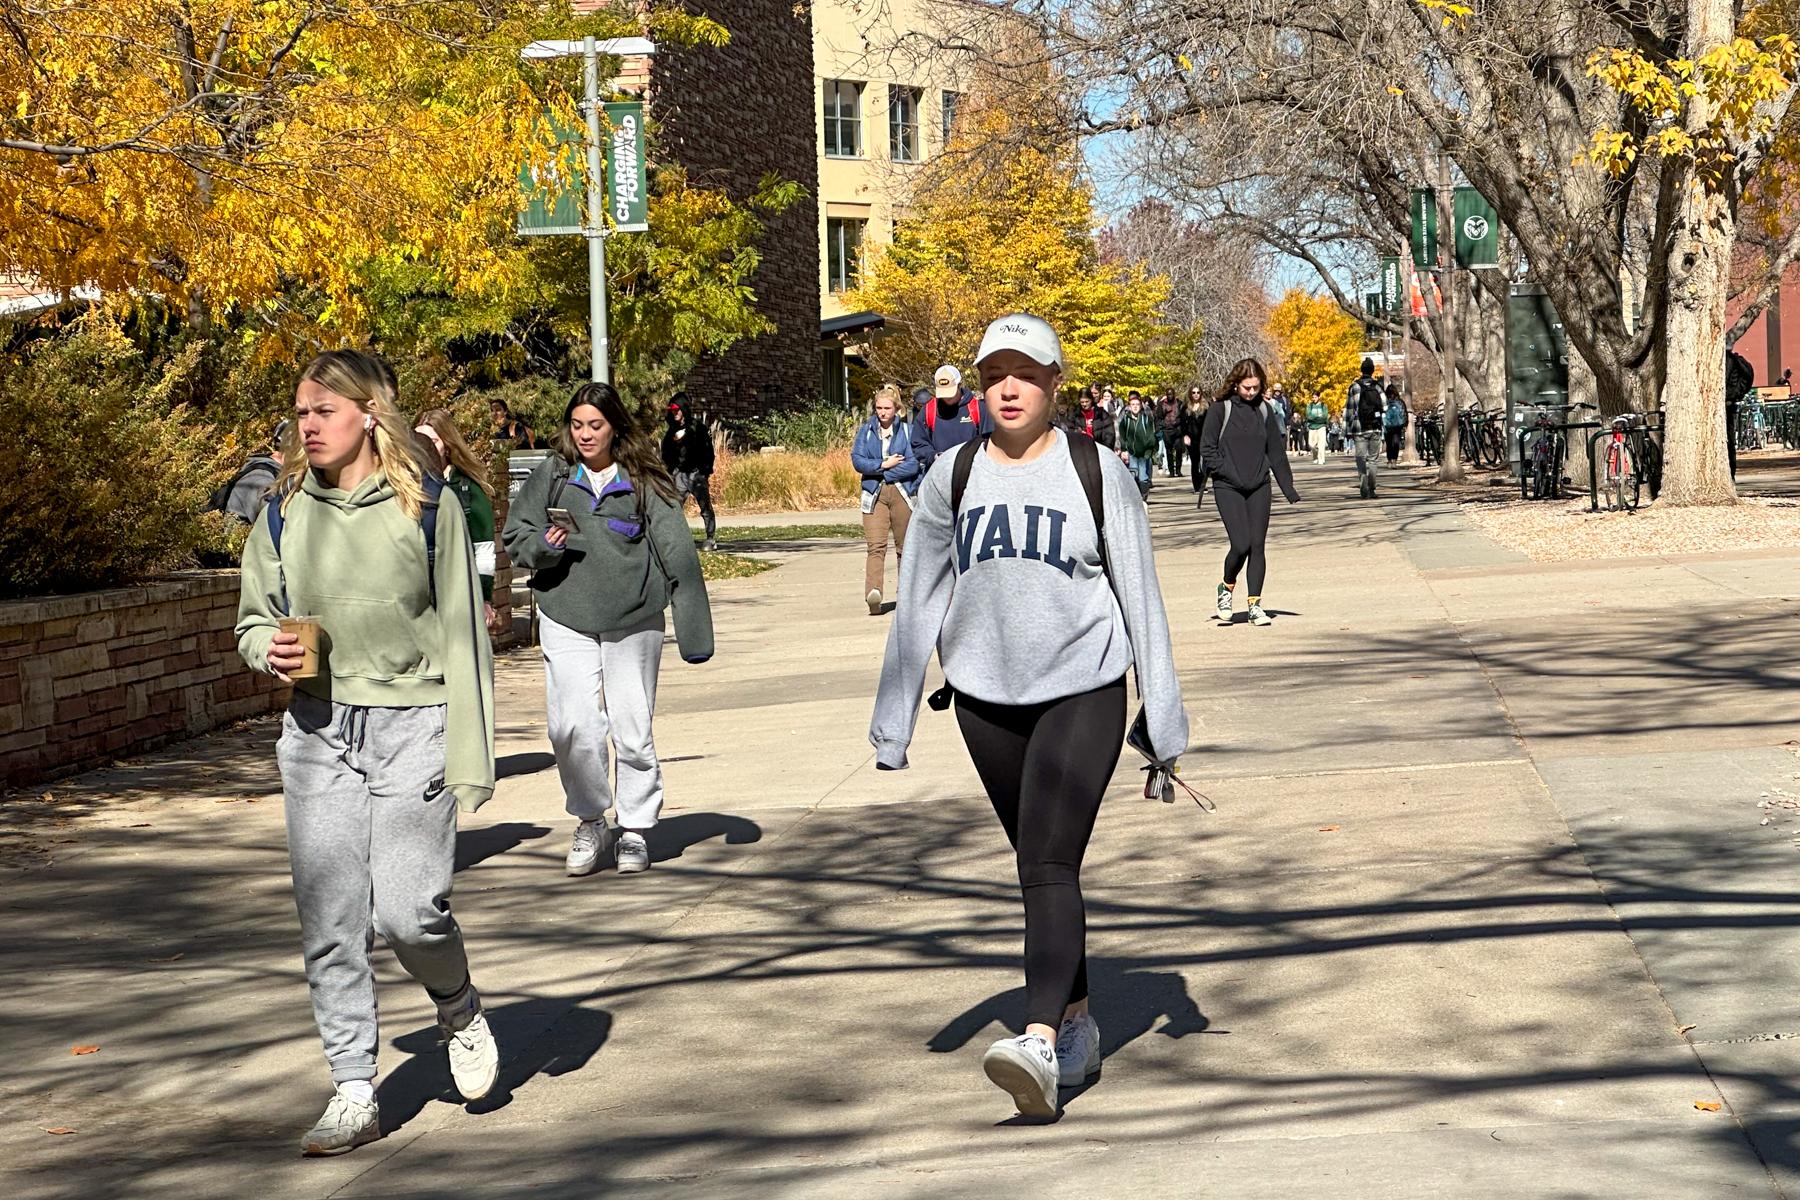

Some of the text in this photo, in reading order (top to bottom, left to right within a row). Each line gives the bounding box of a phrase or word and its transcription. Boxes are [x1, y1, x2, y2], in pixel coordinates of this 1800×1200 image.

[613, 129, 630, 222] CHARGING
[622, 114, 639, 203] FORWARD
[1000, 324, 1028, 336] Nike
[955, 503, 1078, 580] VAIL
